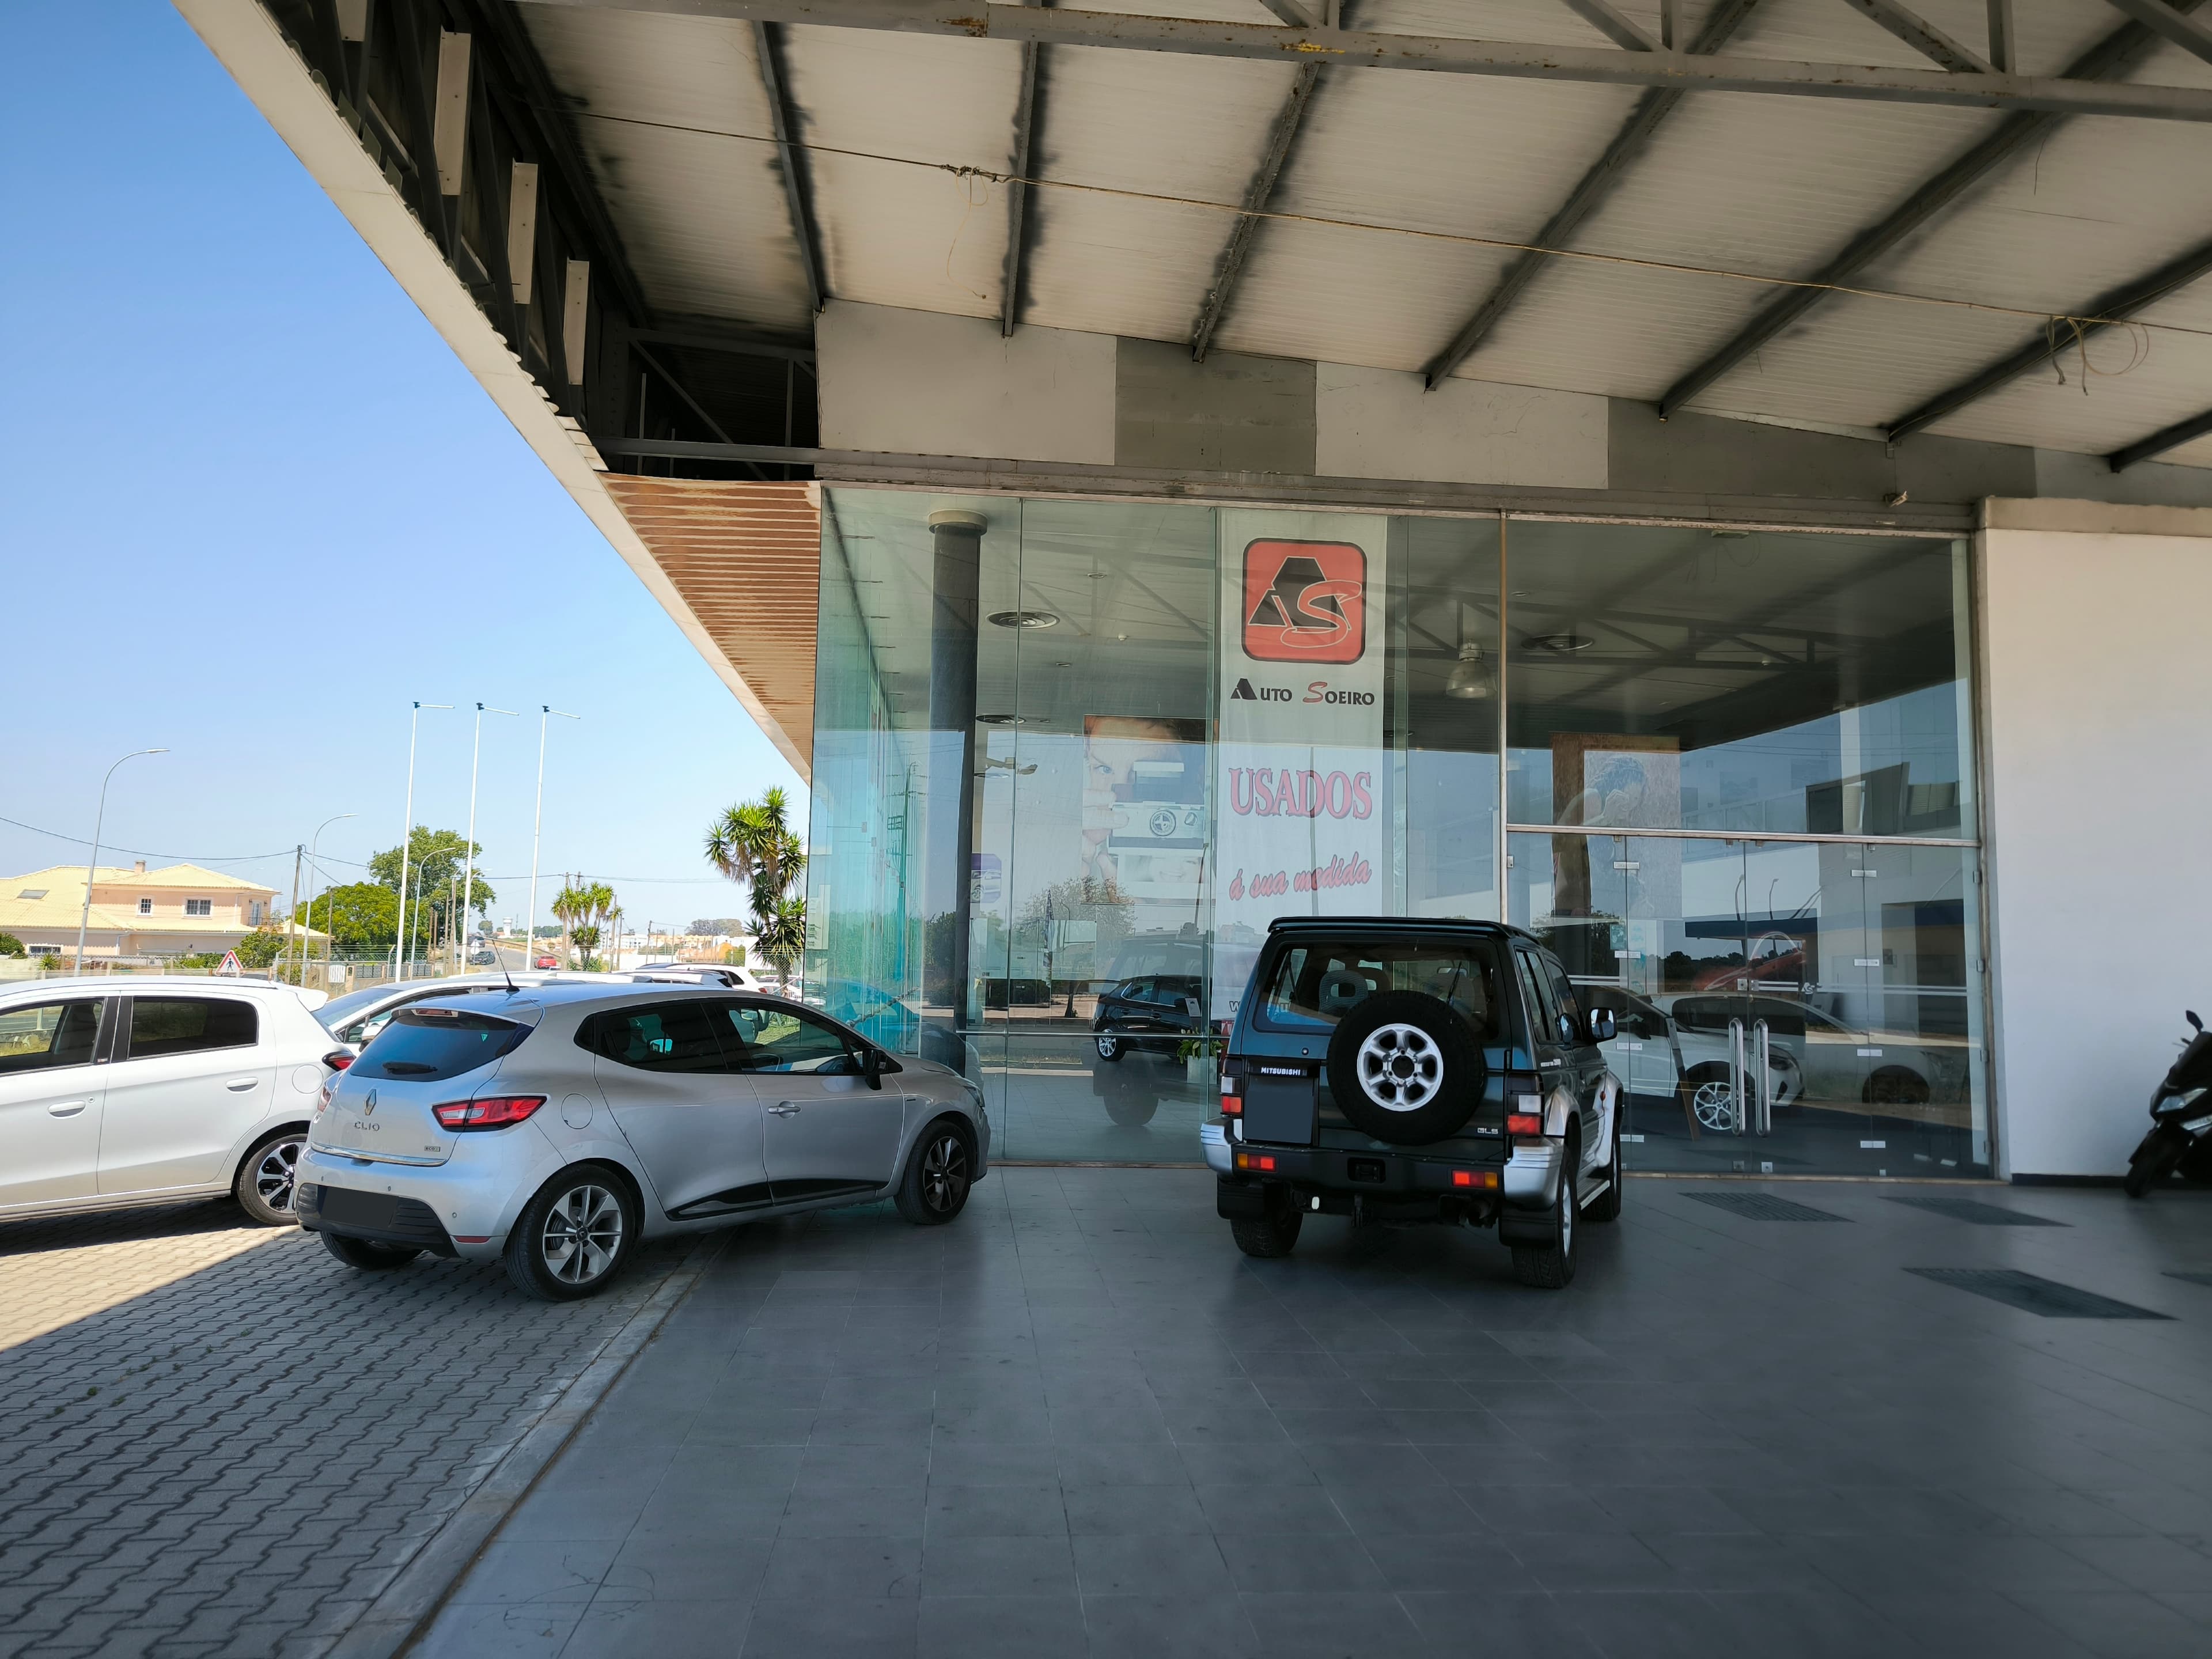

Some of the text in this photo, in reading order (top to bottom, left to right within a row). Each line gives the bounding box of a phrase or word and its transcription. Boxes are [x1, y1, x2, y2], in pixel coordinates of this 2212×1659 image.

[1228, 768, 1372, 820] USADOS
[1249, 871, 1289, 899] sua
[1293, 851, 1372, 891] medida
[1261, 1067, 1300, 1076] MITSUBISHI
[354, 1121, 380, 1131] CLIO
